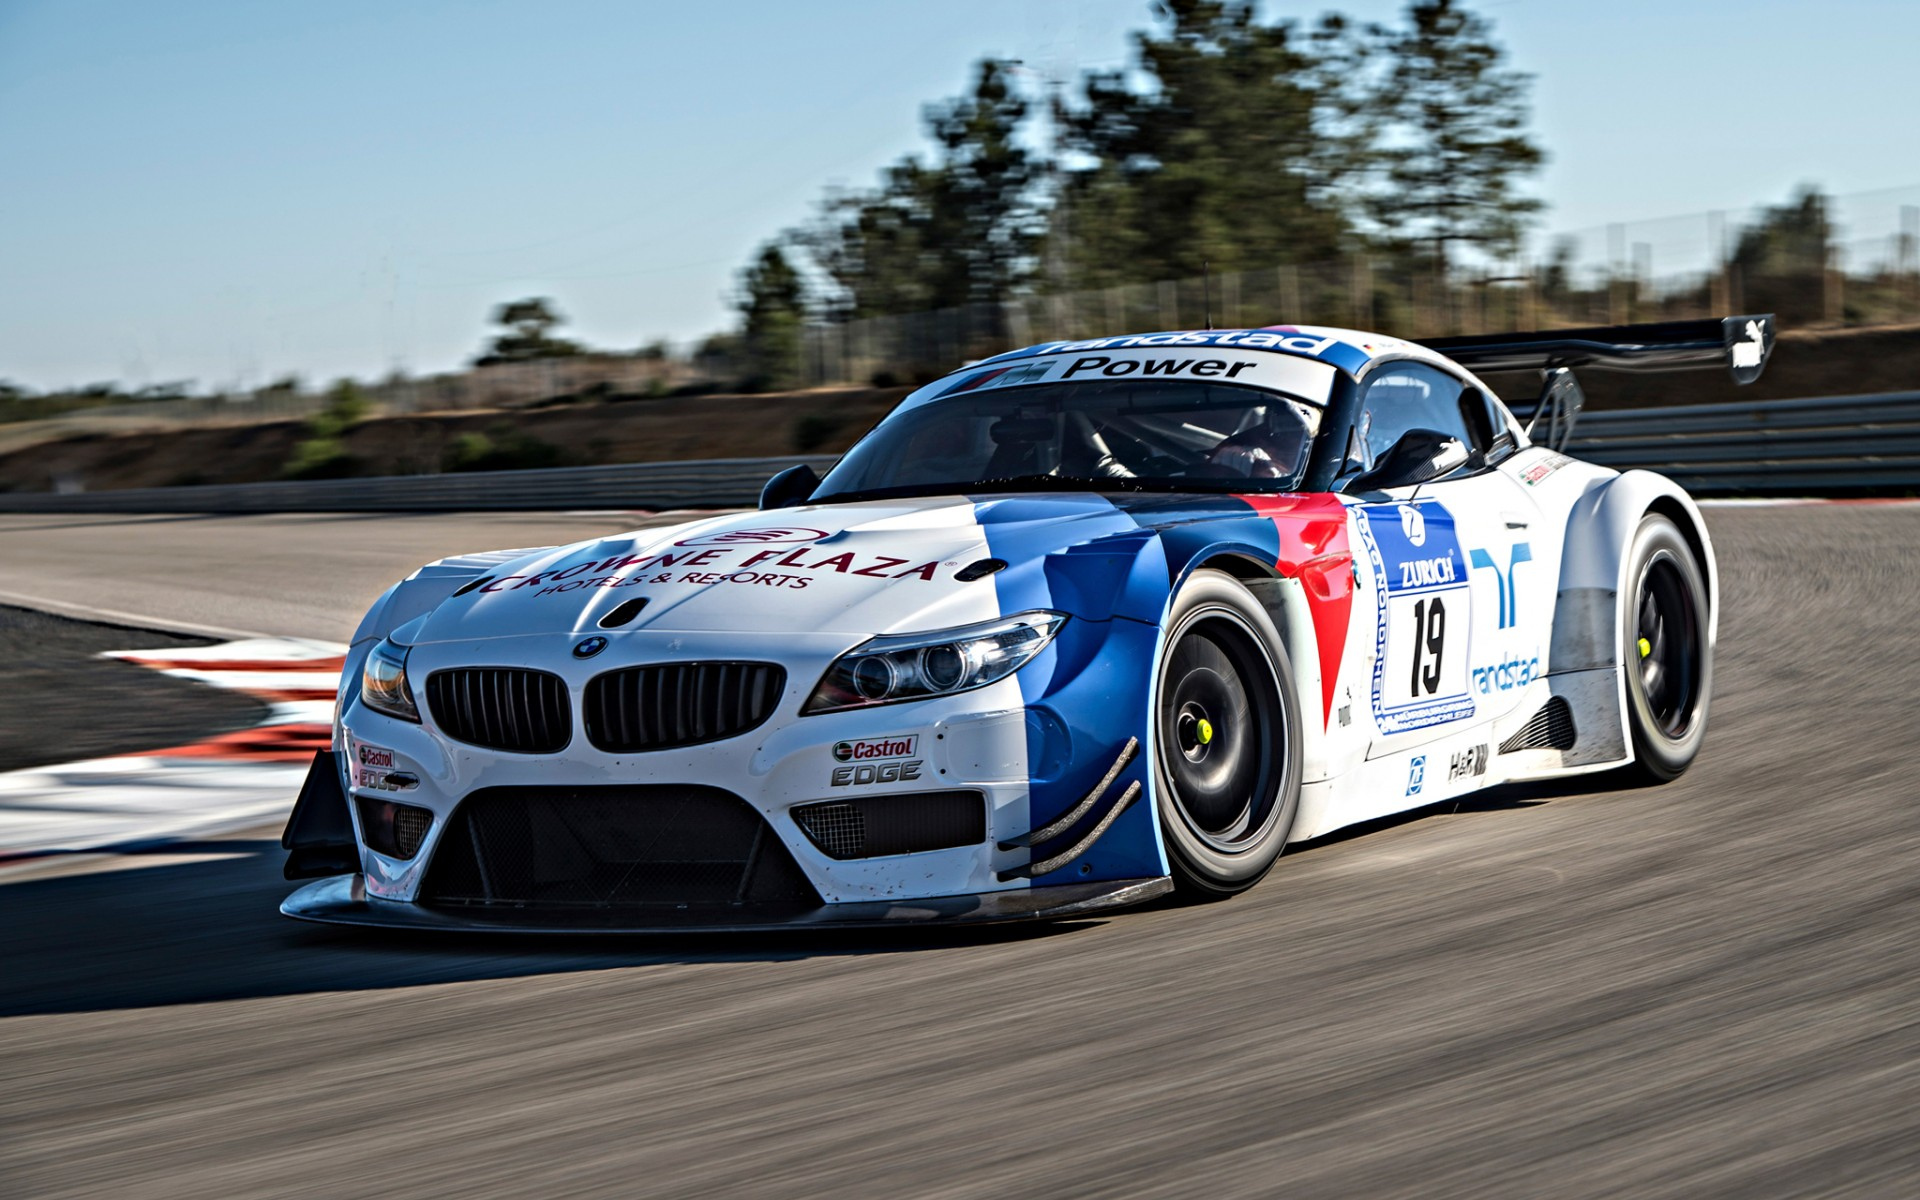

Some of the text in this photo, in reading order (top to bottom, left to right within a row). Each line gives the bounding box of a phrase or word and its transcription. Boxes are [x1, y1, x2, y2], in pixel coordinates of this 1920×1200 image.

[1036, 331, 1338, 357] randstad
[1060, 356, 1258, 379] Power
[478, 547, 939, 594] CROWNE PLAZA
[1398, 556, 1456, 588] ZURICH
[533, 571, 814, 598] HOTELS & RESORTS
[1411, 596, 1446, 698] 19
[1472, 650, 1539, 694] randstad
[366, 749, 393, 768] Castrol
[853, 737, 912, 759] Castrol
[830, 759, 924, 787] EDGE
